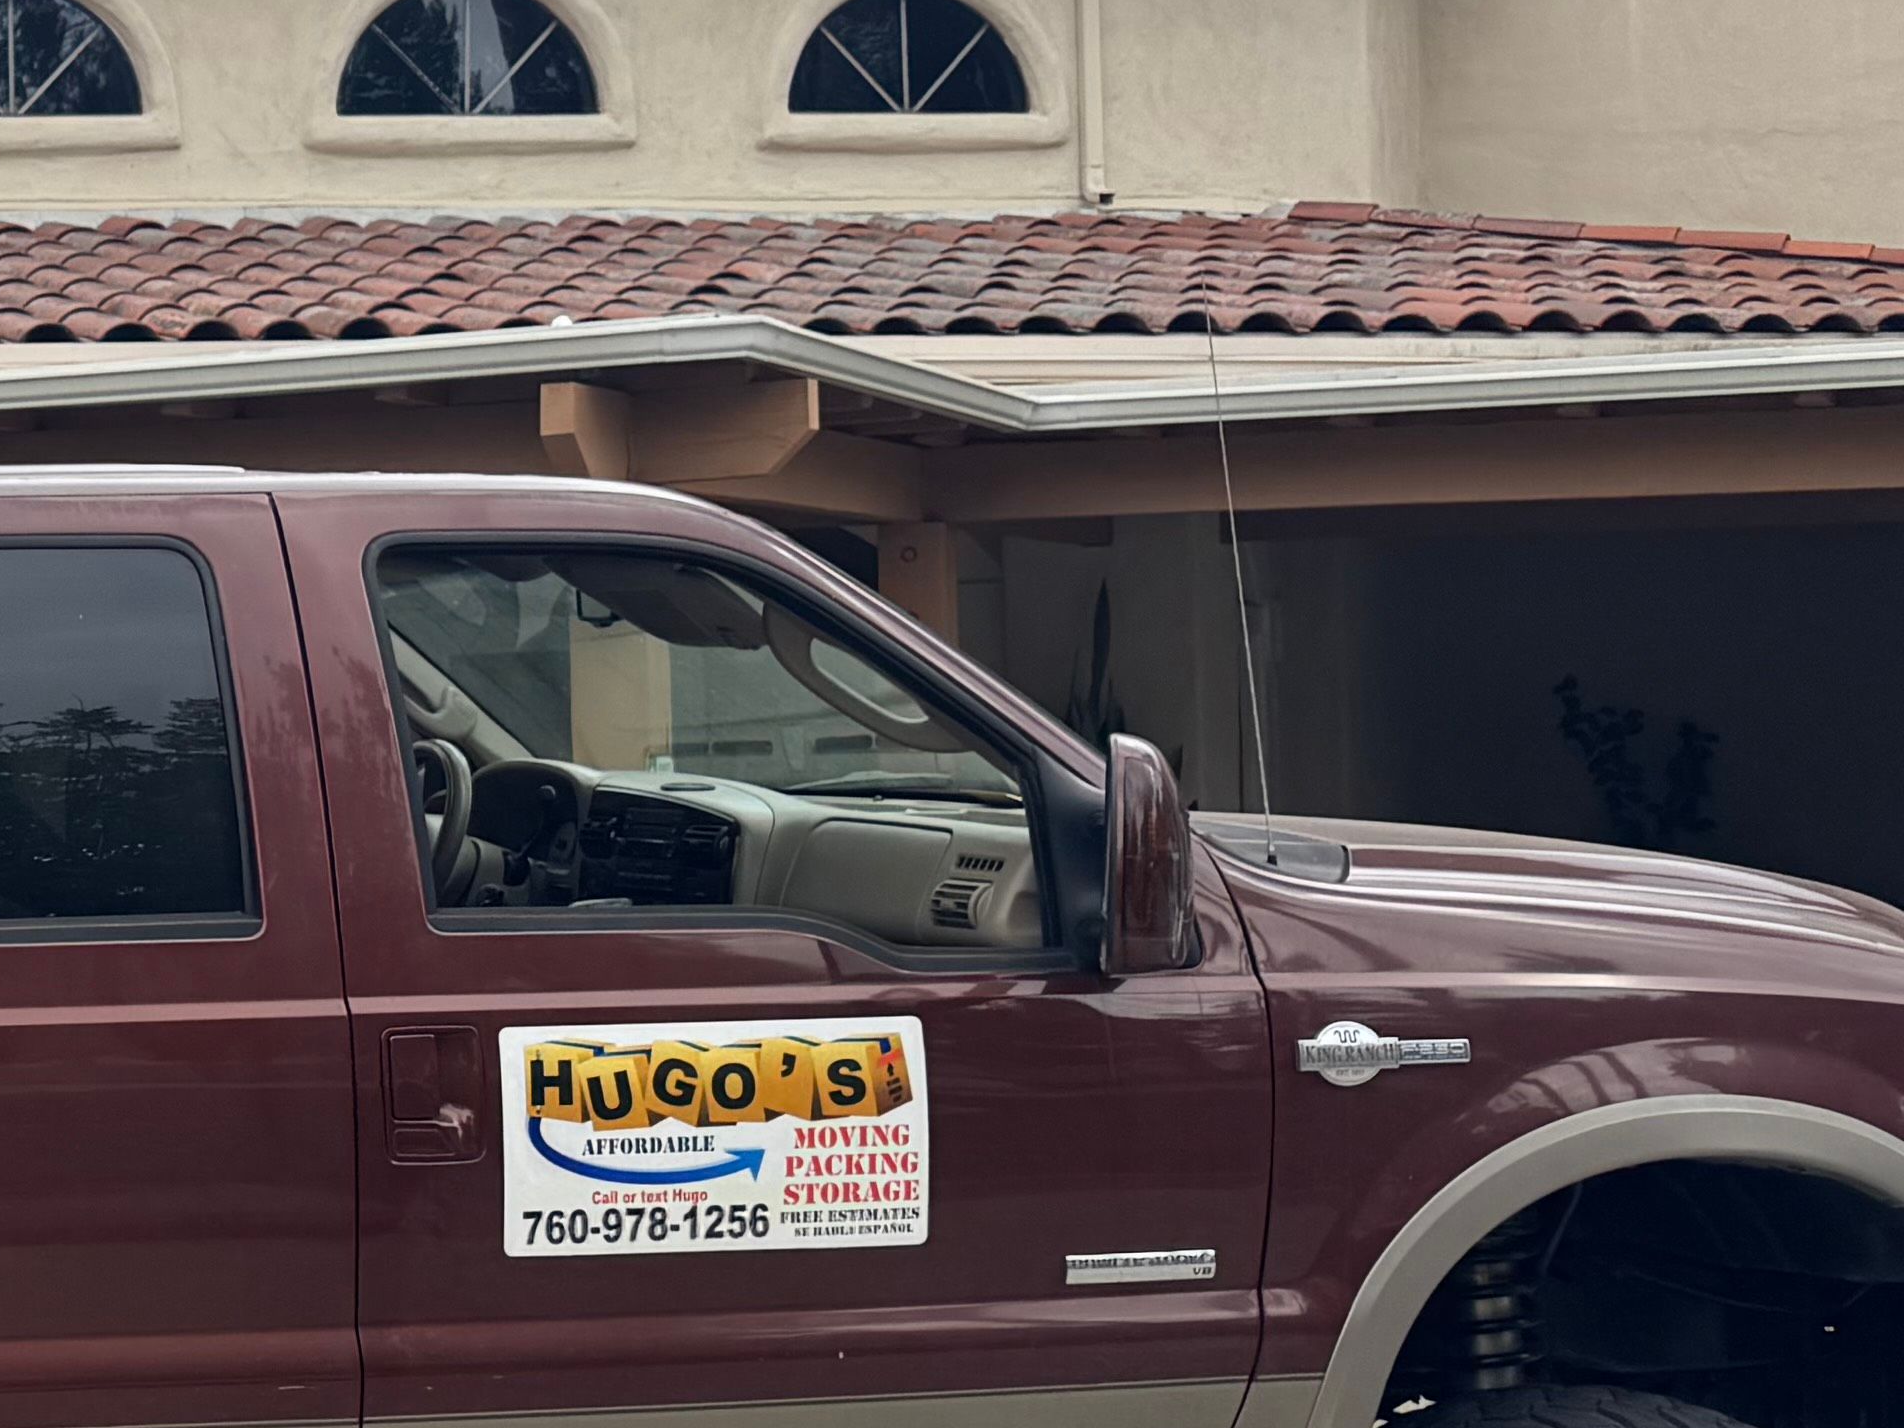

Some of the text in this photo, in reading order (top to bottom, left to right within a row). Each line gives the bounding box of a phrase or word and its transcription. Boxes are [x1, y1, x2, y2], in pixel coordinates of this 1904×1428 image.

[1305, 1043, 1396, 1064] KING RANCH
[529, 1052, 868, 1121] HUGO'S
[582, 1134, 716, 1157] AFFORDABLE
[793, 1123, 910, 1150] MOVING
[784, 1151, 920, 1178] PACKING
[591, 1188, 709, 1206] Call or text Hugo
[782, 1179, 920, 1206] STORAGE
[522, 1203, 770, 1246] 760-978-1256
[779, 1206, 921, 1224] FREE ESTIMATES
